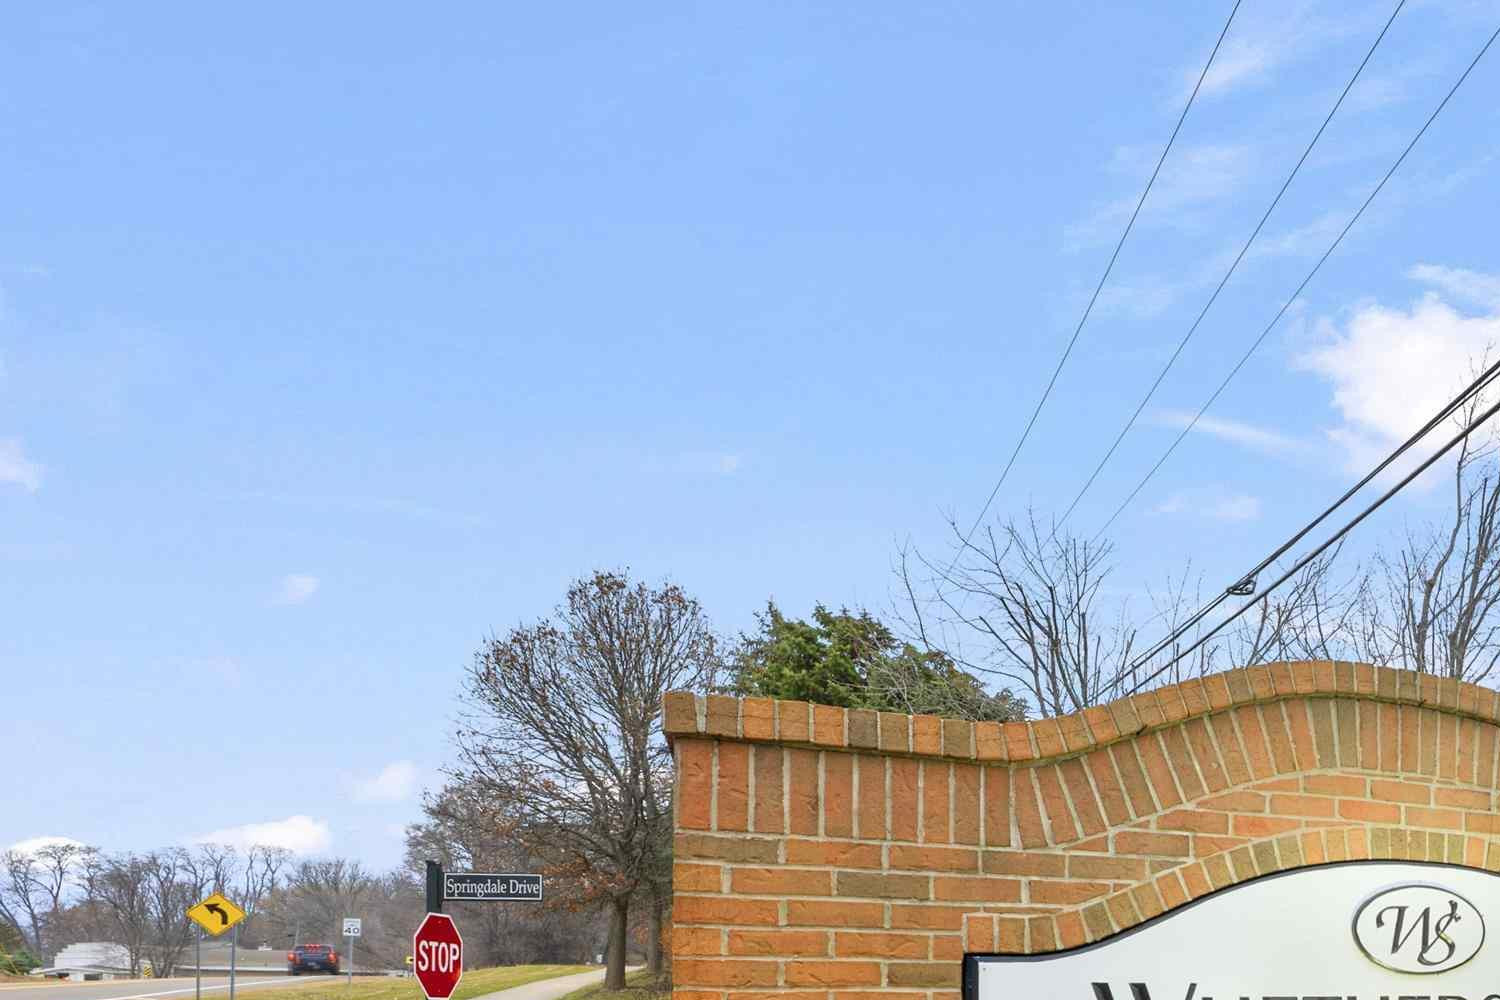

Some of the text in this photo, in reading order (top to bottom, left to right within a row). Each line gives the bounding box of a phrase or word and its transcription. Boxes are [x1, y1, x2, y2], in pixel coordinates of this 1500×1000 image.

[447, 879, 540, 897] Springdale Drive
[344, 927, 360, 935] 40
[418, 940, 460, 973] STOP
